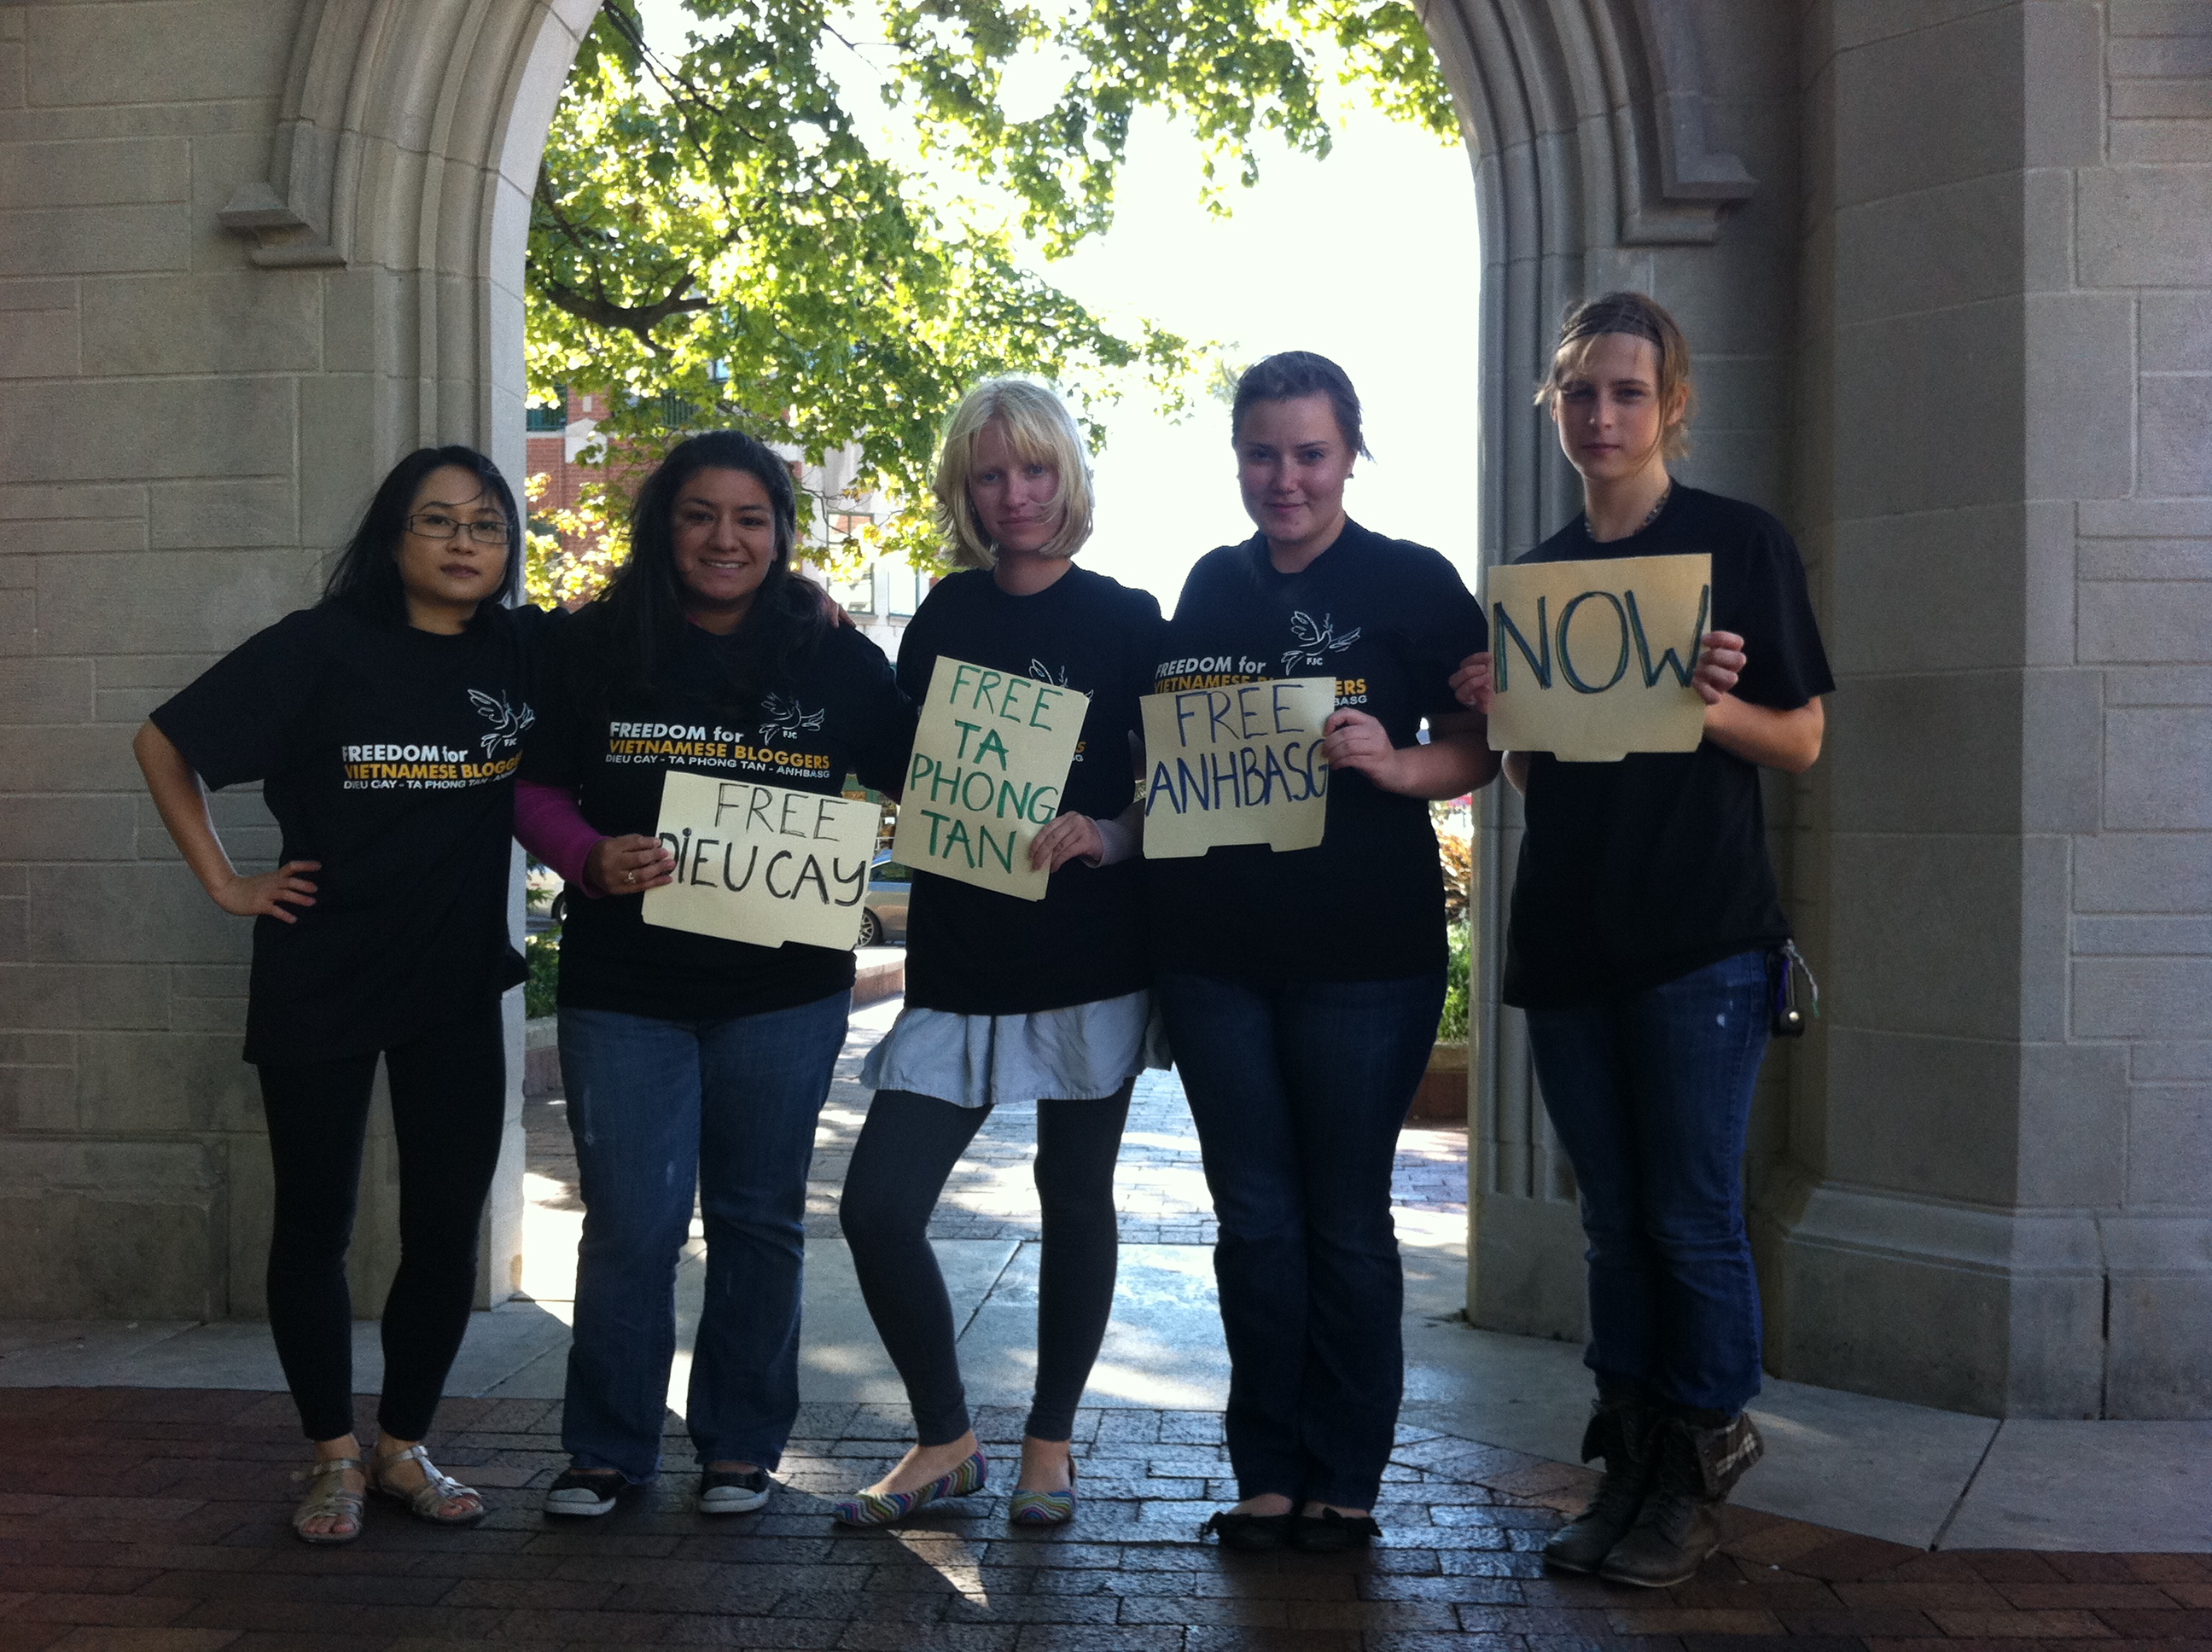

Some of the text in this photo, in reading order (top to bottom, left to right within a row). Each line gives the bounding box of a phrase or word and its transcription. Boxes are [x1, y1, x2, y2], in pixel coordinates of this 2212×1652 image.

[1493, 585, 1710, 694] NOW
[1155, 655, 1266, 680] FREEDOM for
[1307, 657, 1323, 666] FJC
[949, 665, 1063, 731] FREE
[1175, 684, 1305, 747] FREE
[342, 744, 469, 762] FREEDOM for
[609, 722, 744, 743] FREEDOM for
[783, 730, 798, 740] FJC
[955, 718, 1010, 771] TA
[345, 764, 458, 779] VIETNAMESE
[605, 754, 631, 764] DIEU
[633, 754, 658, 765] CAY
[668, 755, 685, 765] TA
[689, 757, 737, 768] PHONG
[740, 759, 765, 771] TAN
[776, 765, 830, 779] ANHBASG
[609, 739, 830, 770] VIETNAMESE BLOGGERS
[343, 780, 369, 789] DIEU
[370, 780, 398, 789] CAY
[406, 780, 423, 789] TA
[425, 780, 467, 789] PHONG
[911, 753, 1058, 825] PHONG
[1144, 739, 1330, 817] ANHBASG
[714, 782, 849, 842] FREE
[921, 809, 1017, 874] TAN
[765, 850, 867, 907] CAY
